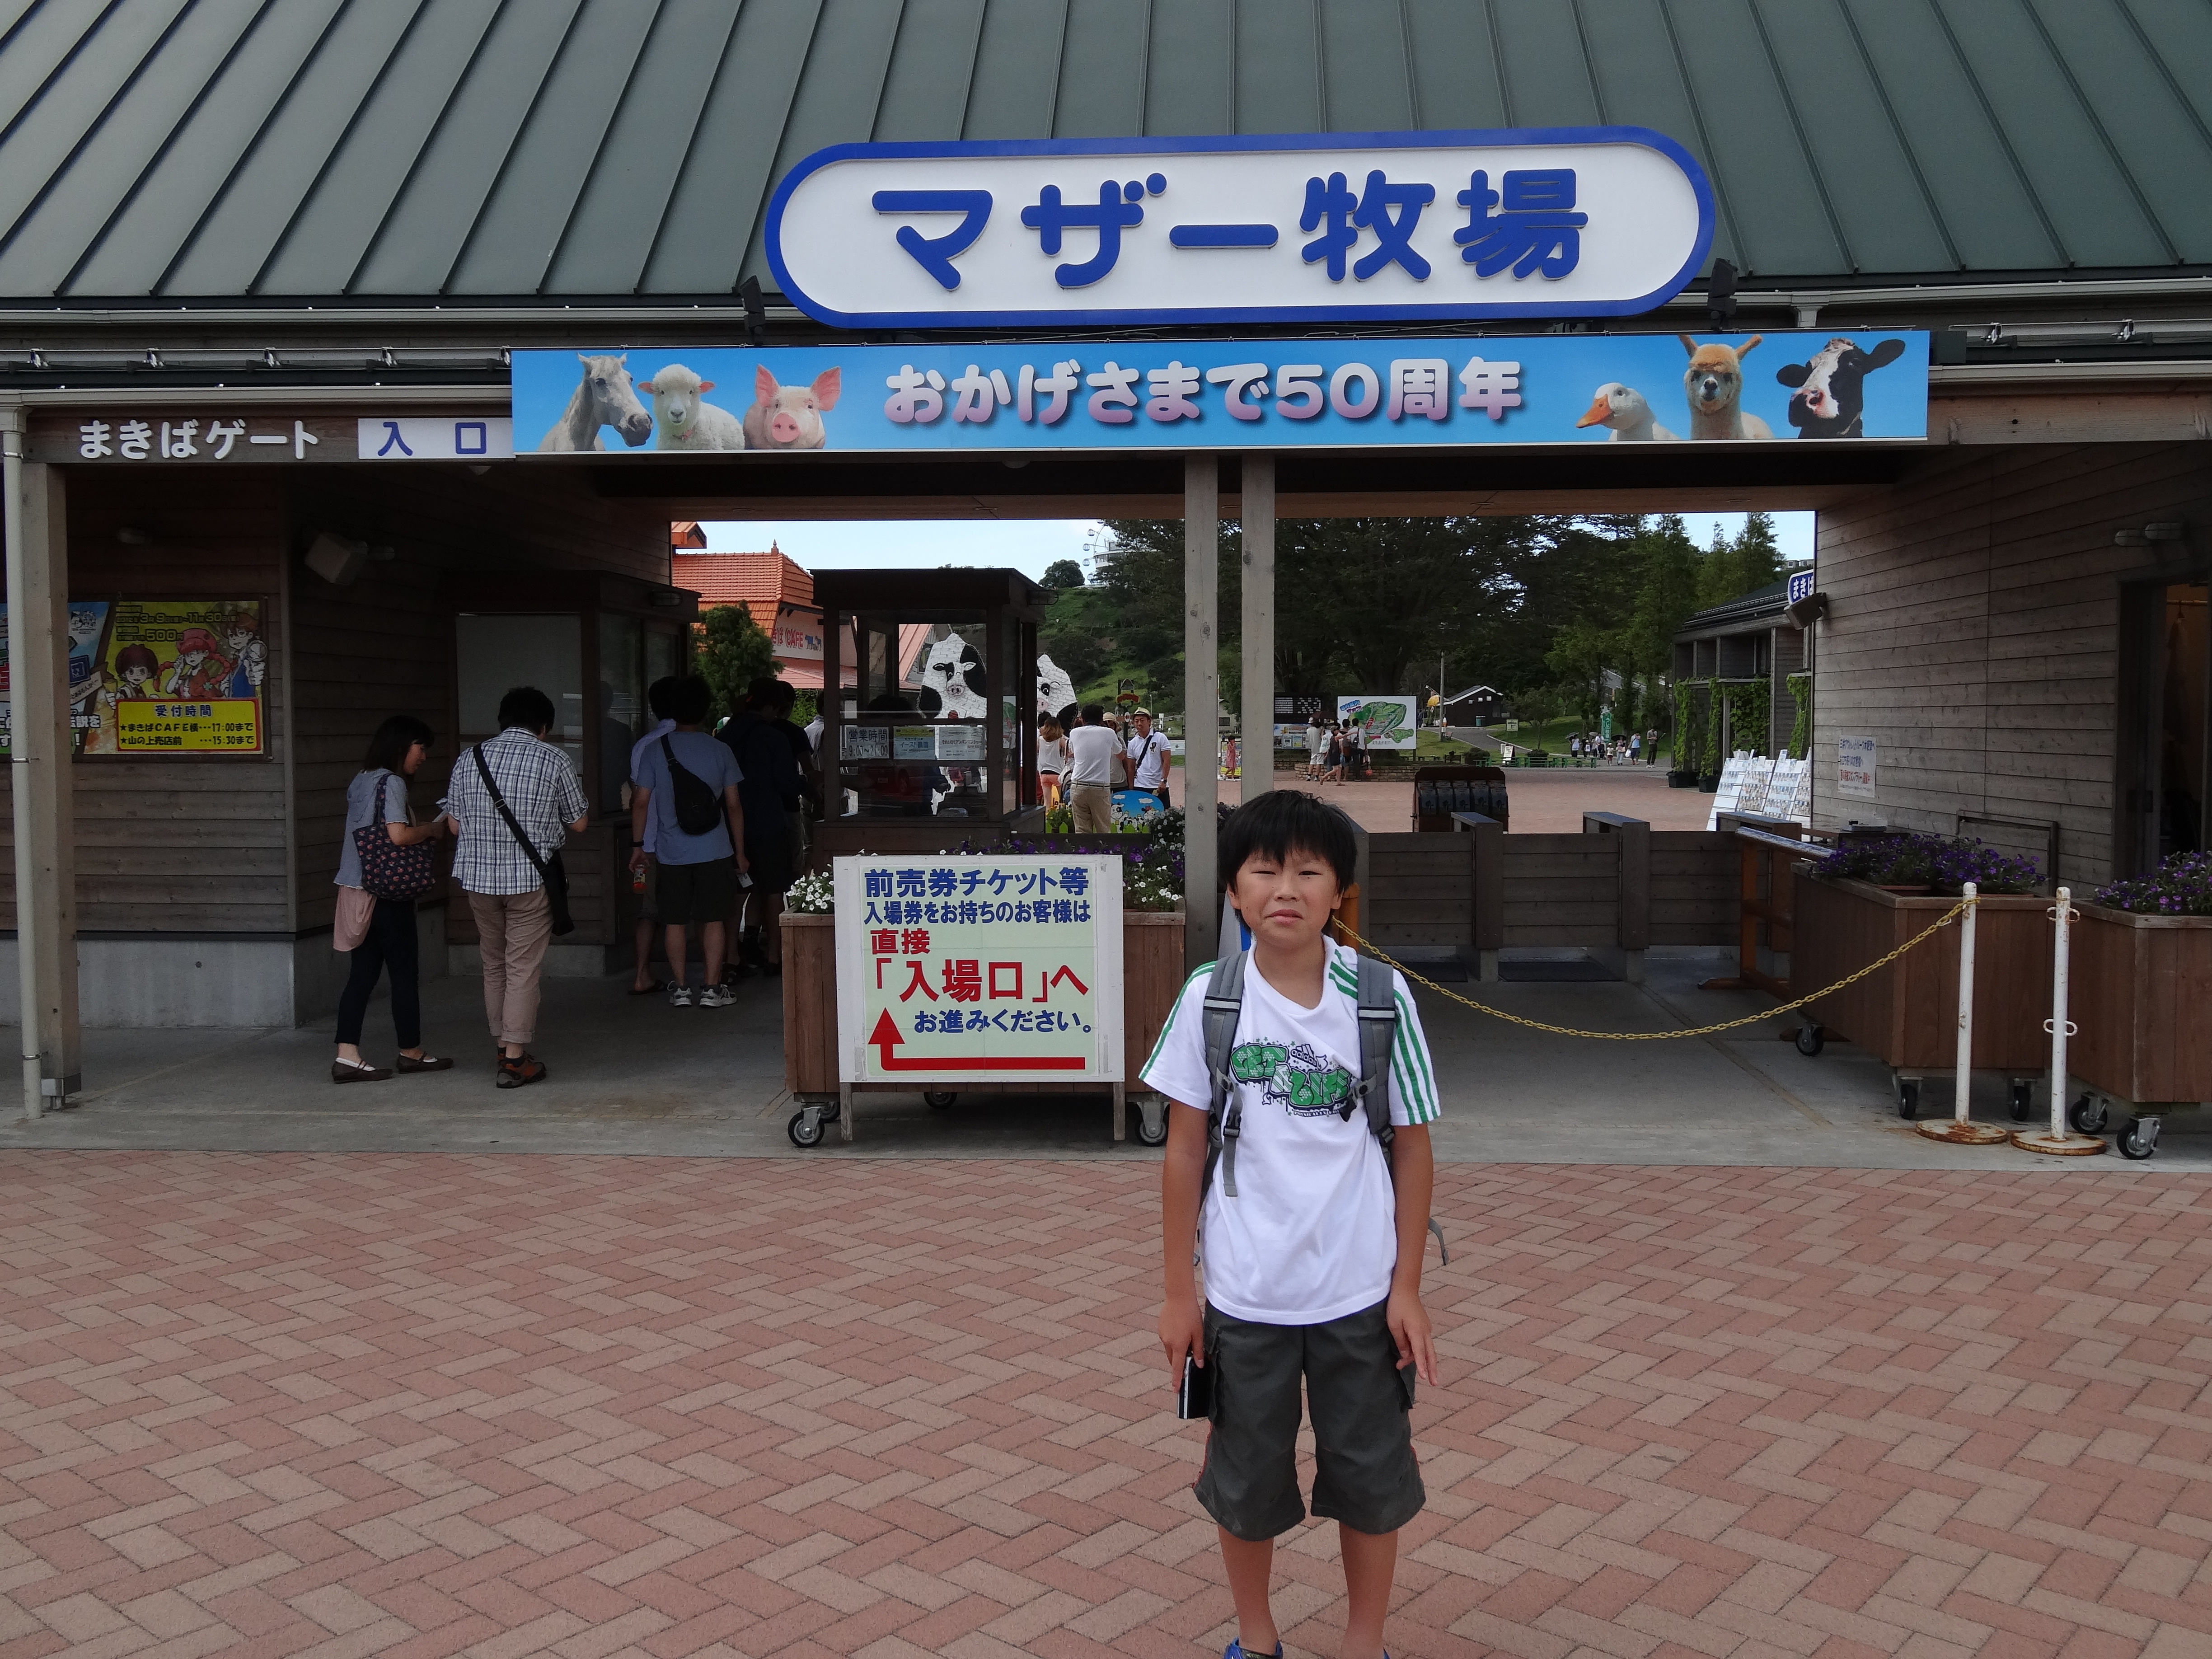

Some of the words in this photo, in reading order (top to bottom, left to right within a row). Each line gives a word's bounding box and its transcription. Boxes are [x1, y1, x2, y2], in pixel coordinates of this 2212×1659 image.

[872, 168, 1589, 292] マザー牧場
[883, 356, 1524, 424] おかげさまで50周年
[79, 418, 319, 460] まきばゲート
[786, 628, 803, 648] CAFE
[155, 704, 212, 717] 受付時間
[849, 729, 887, 742] 営業時間
[864, 867, 1089, 898] 前売券チケット等
[863, 899, 1092, 925] 入場券をお持ちのお客様は
[870, 928, 931, 955] 直接
[876, 959, 1089, 1003] 「入場口」へ
[914, 1009, 1092, 1034] お進みください。
[1290, 1049, 1317, 1067] adidas
